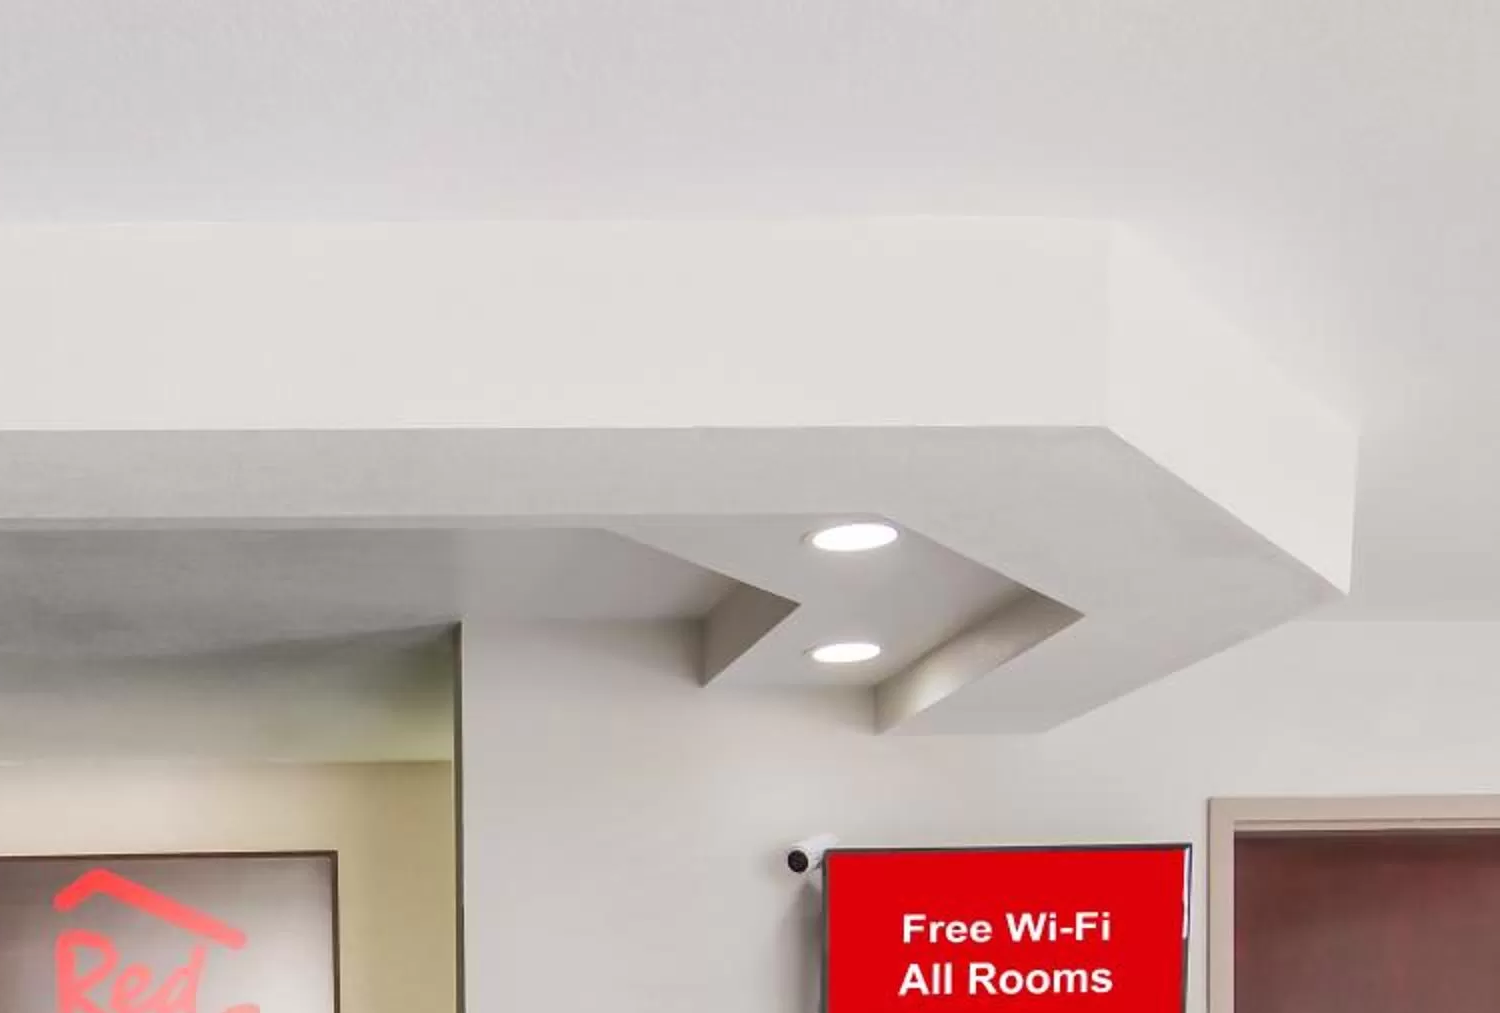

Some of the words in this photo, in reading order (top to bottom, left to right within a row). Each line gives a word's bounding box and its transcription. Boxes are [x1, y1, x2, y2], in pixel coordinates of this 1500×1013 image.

[903, 913, 993, 944] Free
[1005, 911, 1110, 942] Wi-Fi
[898, 962, 953, 996] All
[968, 962, 1113, 995] Rooms
